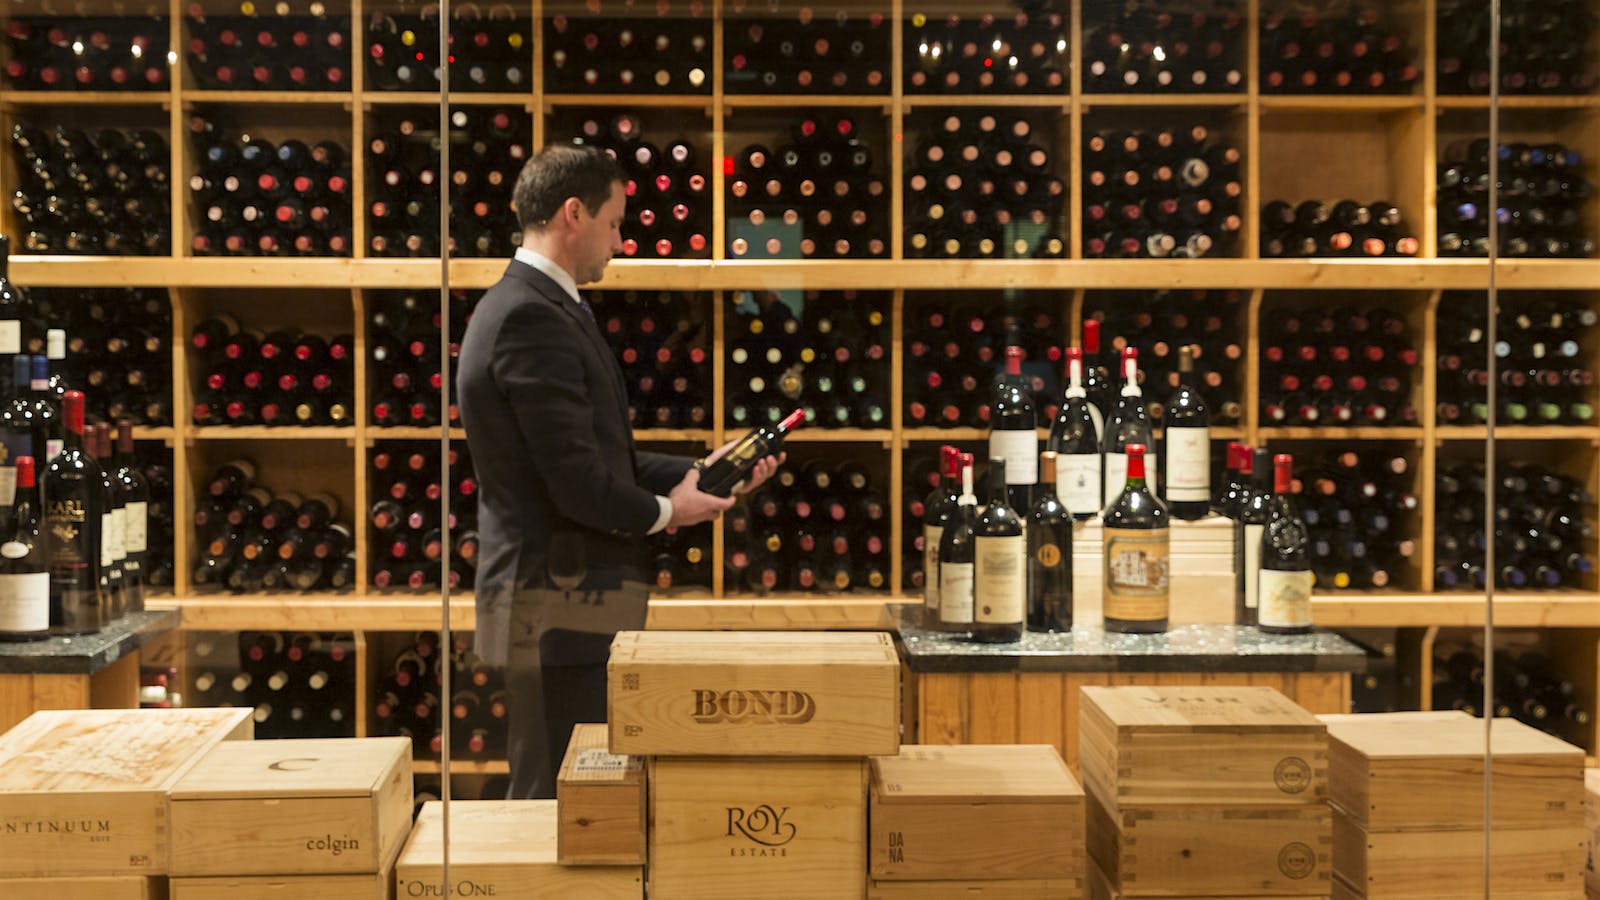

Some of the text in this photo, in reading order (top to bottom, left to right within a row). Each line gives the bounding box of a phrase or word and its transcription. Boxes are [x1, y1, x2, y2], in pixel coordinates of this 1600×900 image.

[691, 689, 816, 724] BOND
[267, 757, 321, 772] C
[0, 820, 110, 834] NTINUUM
[725, 804, 796, 847] ROY
[306, 833, 359, 856] colgin
[888, 831, 904, 848] DA
[730, 847, 787, 857] ESTATE
[888, 848, 904, 863] NA
